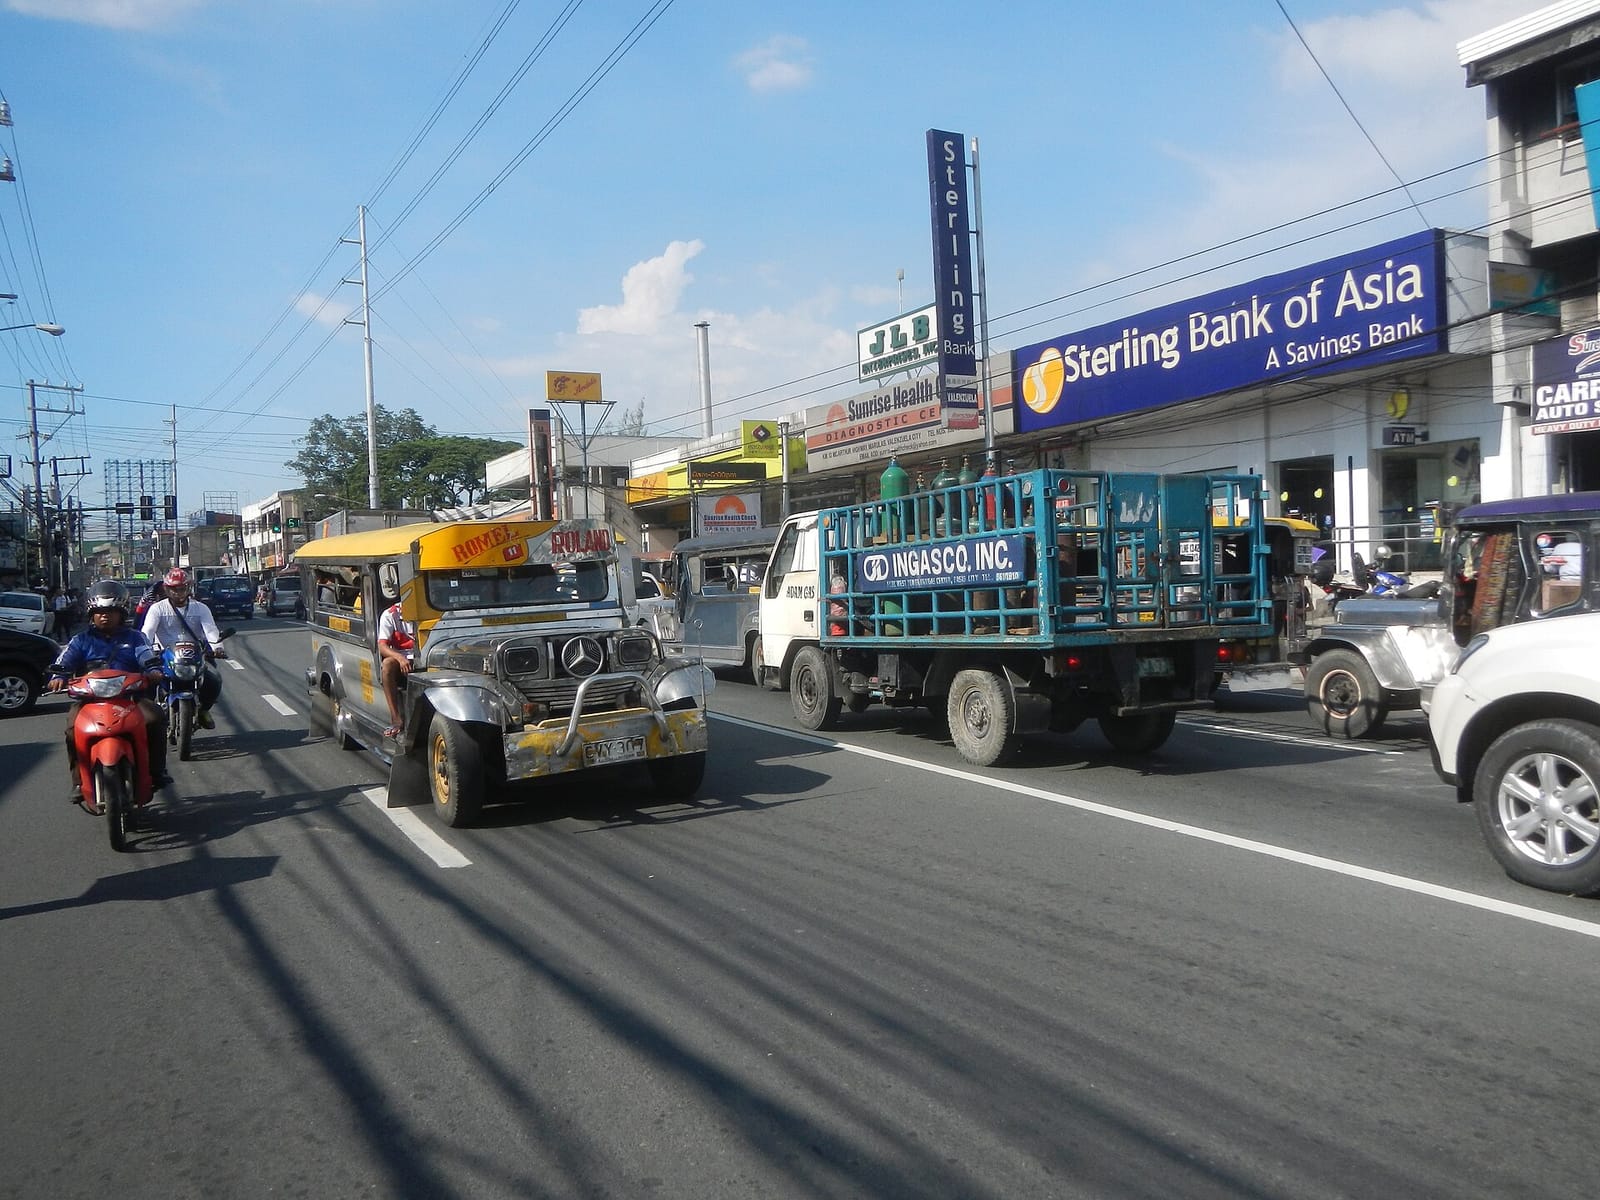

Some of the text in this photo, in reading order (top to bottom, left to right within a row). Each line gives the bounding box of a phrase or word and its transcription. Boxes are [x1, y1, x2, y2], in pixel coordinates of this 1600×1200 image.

[943, 140, 965, 335] Sterling
[1065, 326, 1180, 383] Sterling
[1189, 296, 1273, 353] Bank
[1284, 278, 1324, 329] of
[1334, 259, 1424, 318] Asia
[944, 339, 975, 355] Bank
[1265, 313, 1424, 370] A Savings Bank
[848, 394, 891, 421] Sunrise
[893, 378, 933, 410] Health
[1536, 402, 1589, 420] AUTO
[826, 414, 908, 442] DIAGNOSTIC
[1393, 432, 1415, 443] ATM
[1534, 423, 1567, 434] HEAVY
[452, 524, 519, 562] ROMEL
[551, 528, 611, 555] ROLAND
[975, 539, 1013, 571] INC.
[786, 585, 815, 599] ADAM GAS
